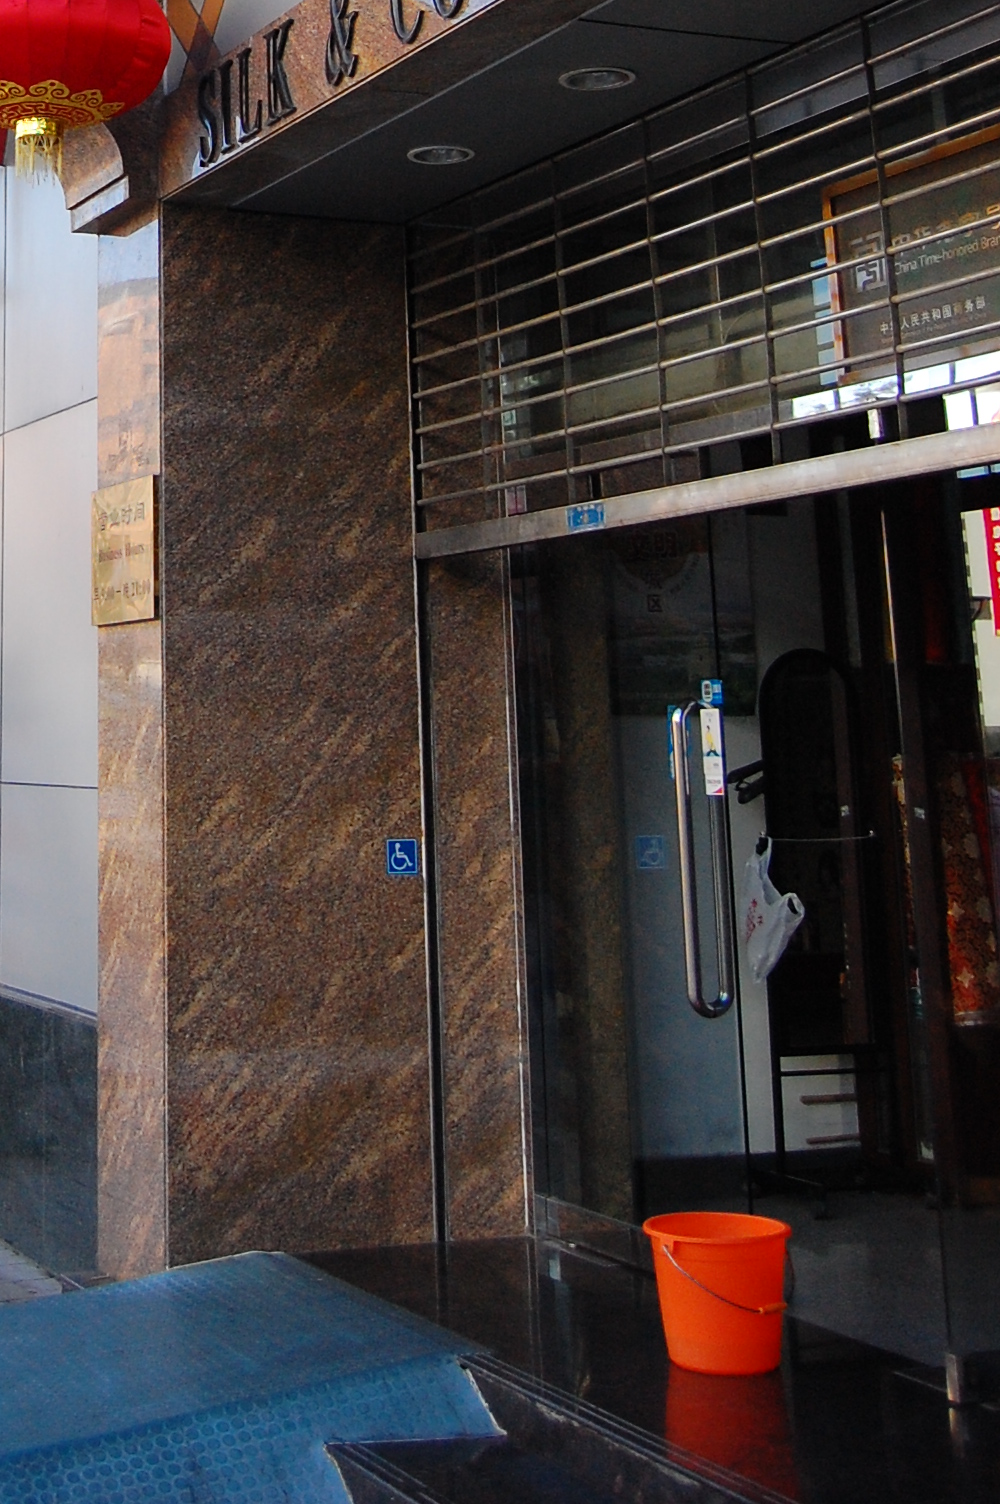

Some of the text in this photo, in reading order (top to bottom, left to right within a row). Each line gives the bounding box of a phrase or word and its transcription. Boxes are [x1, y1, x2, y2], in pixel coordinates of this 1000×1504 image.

[199, 18, 297, 168] SILK
[918, 241, 979, 267] Time-honored
[879, 295, 986, 335] 中人民共和国商务部
